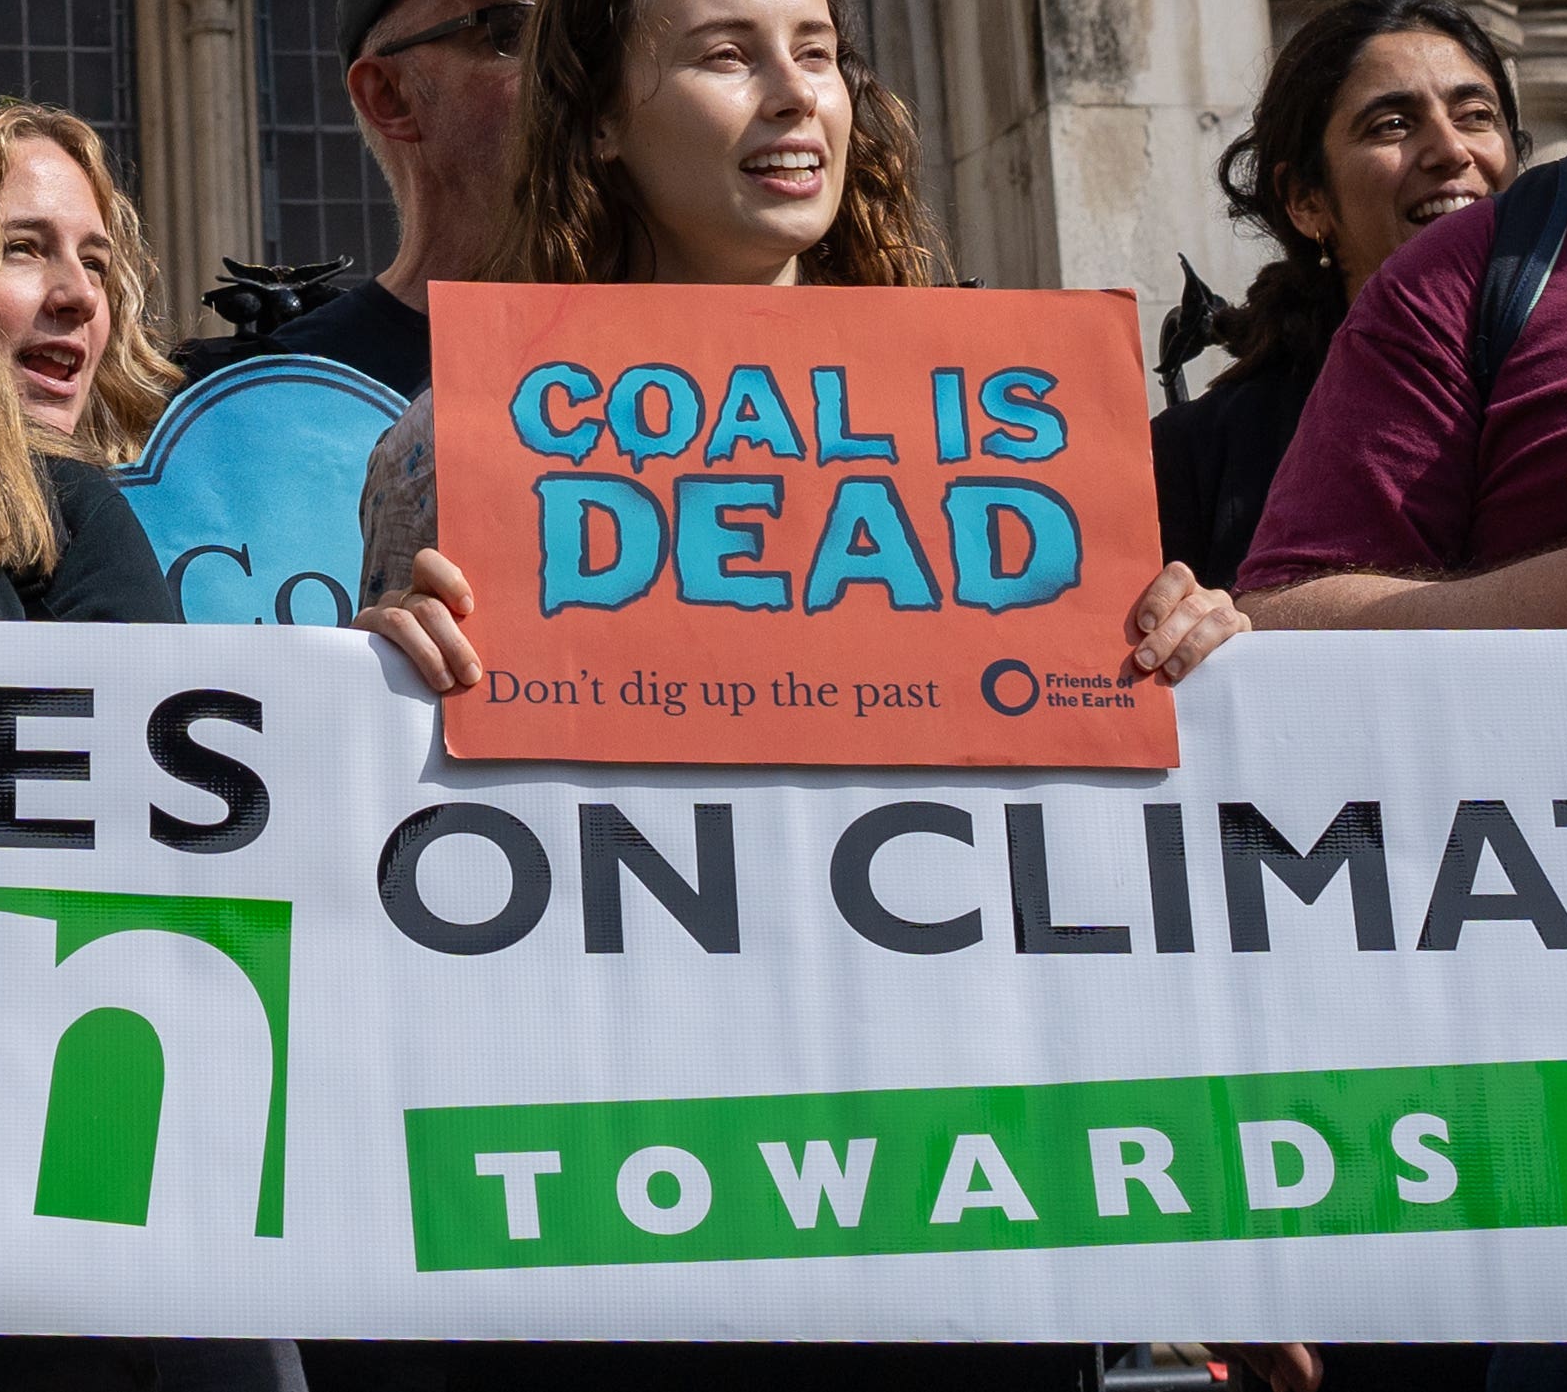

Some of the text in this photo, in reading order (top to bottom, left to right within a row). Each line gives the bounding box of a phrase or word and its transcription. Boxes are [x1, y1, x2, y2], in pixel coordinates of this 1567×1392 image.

[509, 359, 1068, 472] COAL IS
[533, 471, 1085, 617] DEAD
[485, 667, 942, 719] Don’t dig up the past
[1045, 673, 1134, 689] Friends of
[1046, 692, 1135, 708] the Earth
[377, 801, 741, 956] ON
[475, 1111, 1459, 1239] TOWARDS
